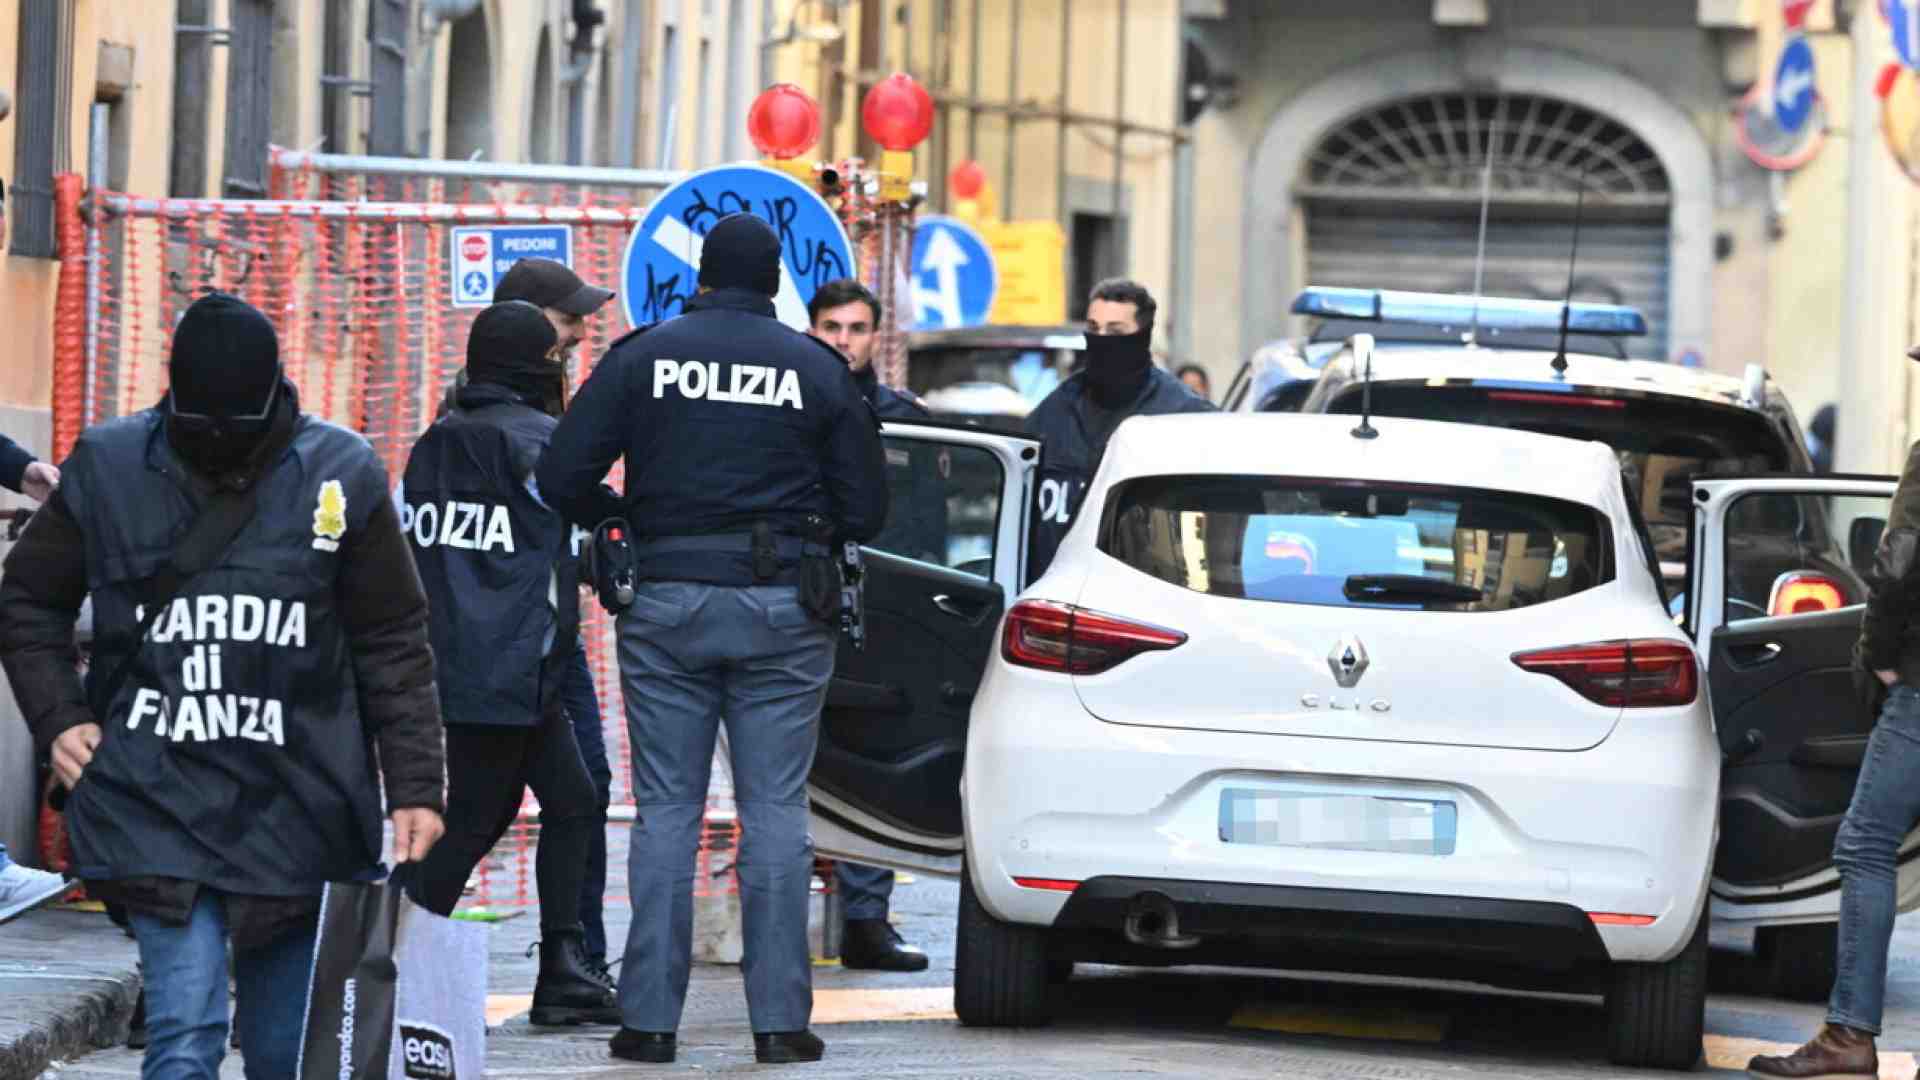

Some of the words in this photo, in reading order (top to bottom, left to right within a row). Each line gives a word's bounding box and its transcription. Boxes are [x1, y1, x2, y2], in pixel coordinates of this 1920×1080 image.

[503, 237, 557, 252] PEDONI
[652, 358, 804, 410] POLIZIA
[400, 500, 515, 553] POIZIA
[182, 643, 222, 692] di
[1300, 693, 1392, 712] CLIO
